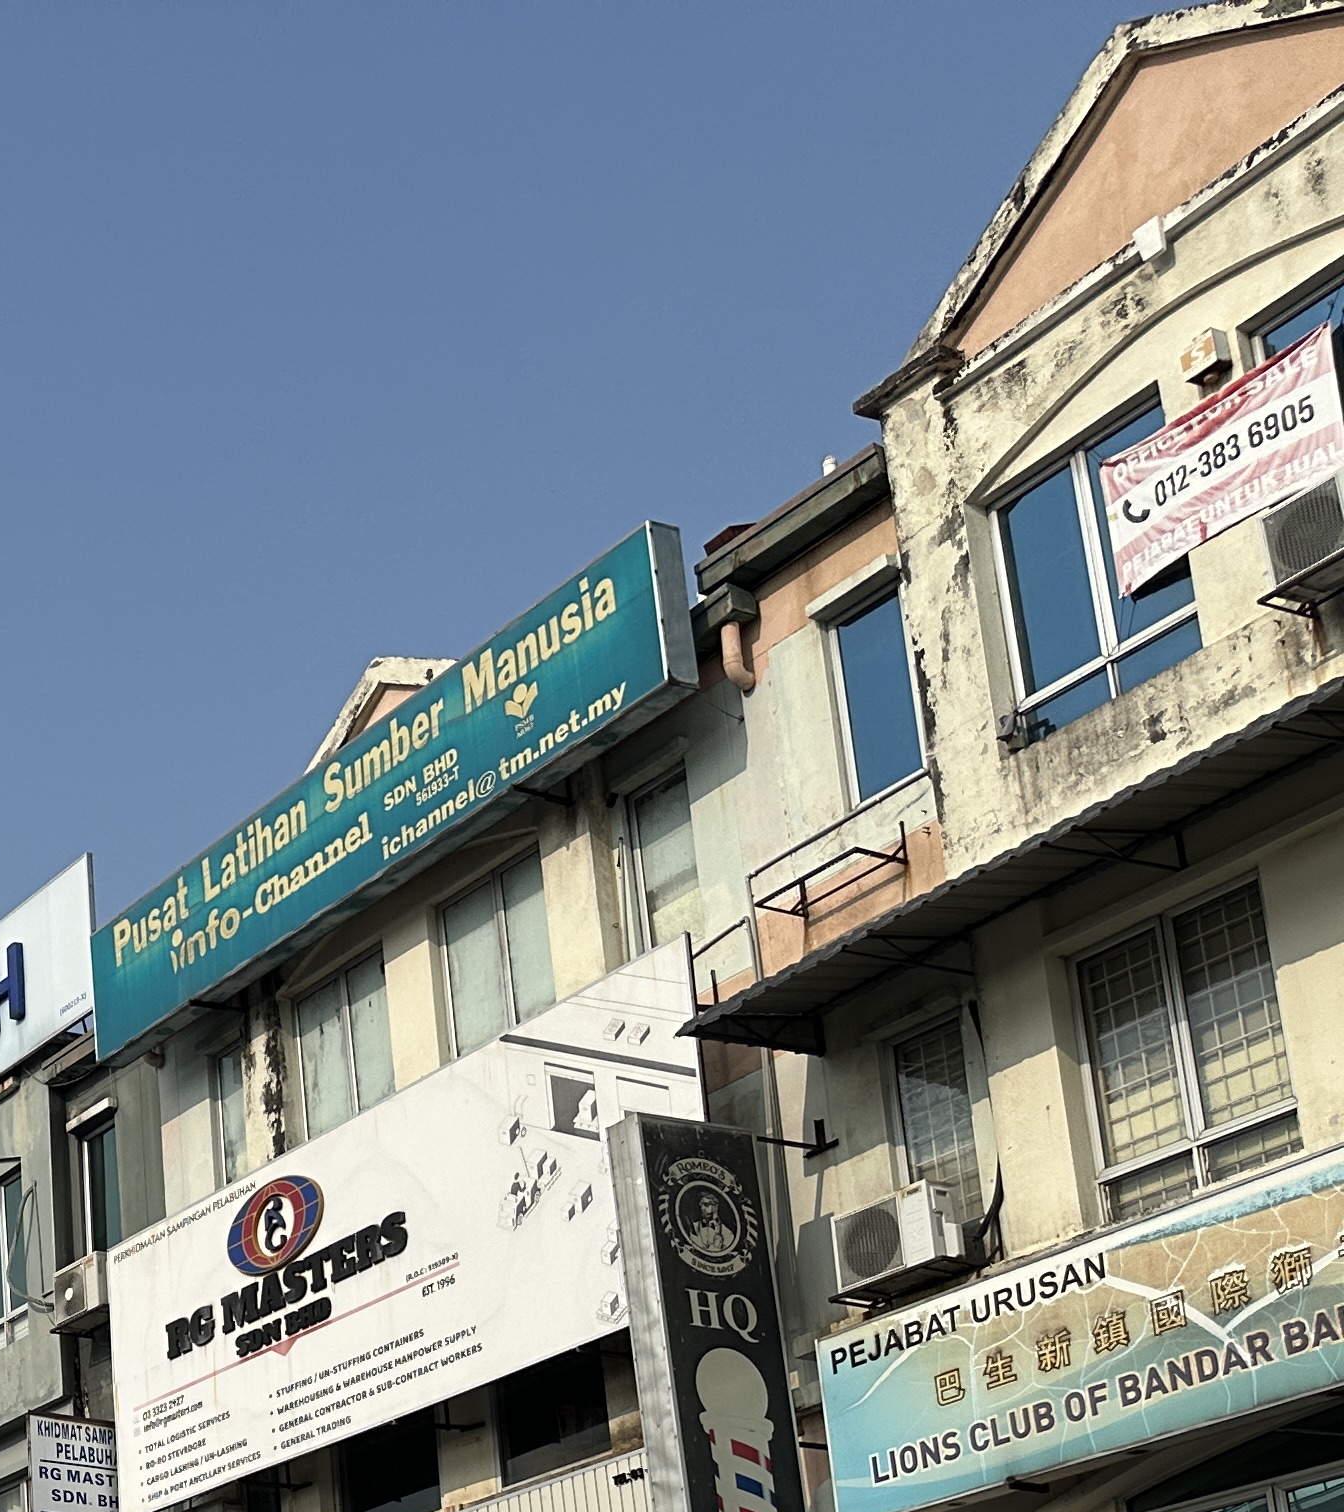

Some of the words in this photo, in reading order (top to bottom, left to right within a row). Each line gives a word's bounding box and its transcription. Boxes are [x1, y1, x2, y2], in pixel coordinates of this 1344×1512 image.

[1154, 432, 1242, 507] 012-383
[1248, 395, 1315, 449] 6905
[112, 878, 189, 968] Pusat
[202, 798, 308, 904] Latihan
[323, 697, 446, 813] Sumber
[461, 574, 618, 715] Manusia
[383, 775, 418, 812] SDN
[423, 748, 459, 784] BHD
[675, 1161, 727, 1181] ROMEO'S
[165, 1304, 216, 1361] RG
[220, 1210, 409, 1336] MASTERS
[684, 1287, 760, 1344] HQ
[830, 1304, 962, 1376] PEJABAT
[971, 1252, 1108, 1325] URUSAN
[235, 1318, 283, 1358] SDN
[285, 1297, 333, 1336] BHD
[933, 1235, 1344, 1408] 巴生新鎮國際獅
[276, 1374, 313, 1399] STUFFING
[318, 1351, 372, 1382] UN-STUFFING
[372, 1328, 425, 1360] CONTAINERS
[276, 1384, 335, 1416] WAREHOUSING
[342, 1359, 394, 1392] WAREHOUSE
[394, 1341, 443, 1369] MANPOWER
[444, 1325, 478, 1350] SUPPLY
[278, 1408, 314, 1433] GENERAL
[314, 1386, 369, 1419] CONTRACTOR
[376, 1359, 439, 1395] SUB-CONTRACT
[438, 1342, 483, 1370] WORKERS
[36, 1419, 83, 1443] KHIDMAT
[145, 1437, 166, 1454] TOTAL
[197, 1410, 231, 1435] SERVICES
[280, 1427, 316, 1451] GENERAL
[315, 1414, 352, 1438] TRADING
[870, 1429, 961, 1488] LIONS
[968, 1400, 1056, 1455] CLUB
[1064, 1381, 1109, 1425] OF
[1116, 1328, 1274, 1411] BANDAR
[38, 1466, 62, 1482] RG
[227, 1450, 262, 1474] SERVICES
[51, 1489, 93, 1506] SDN.
